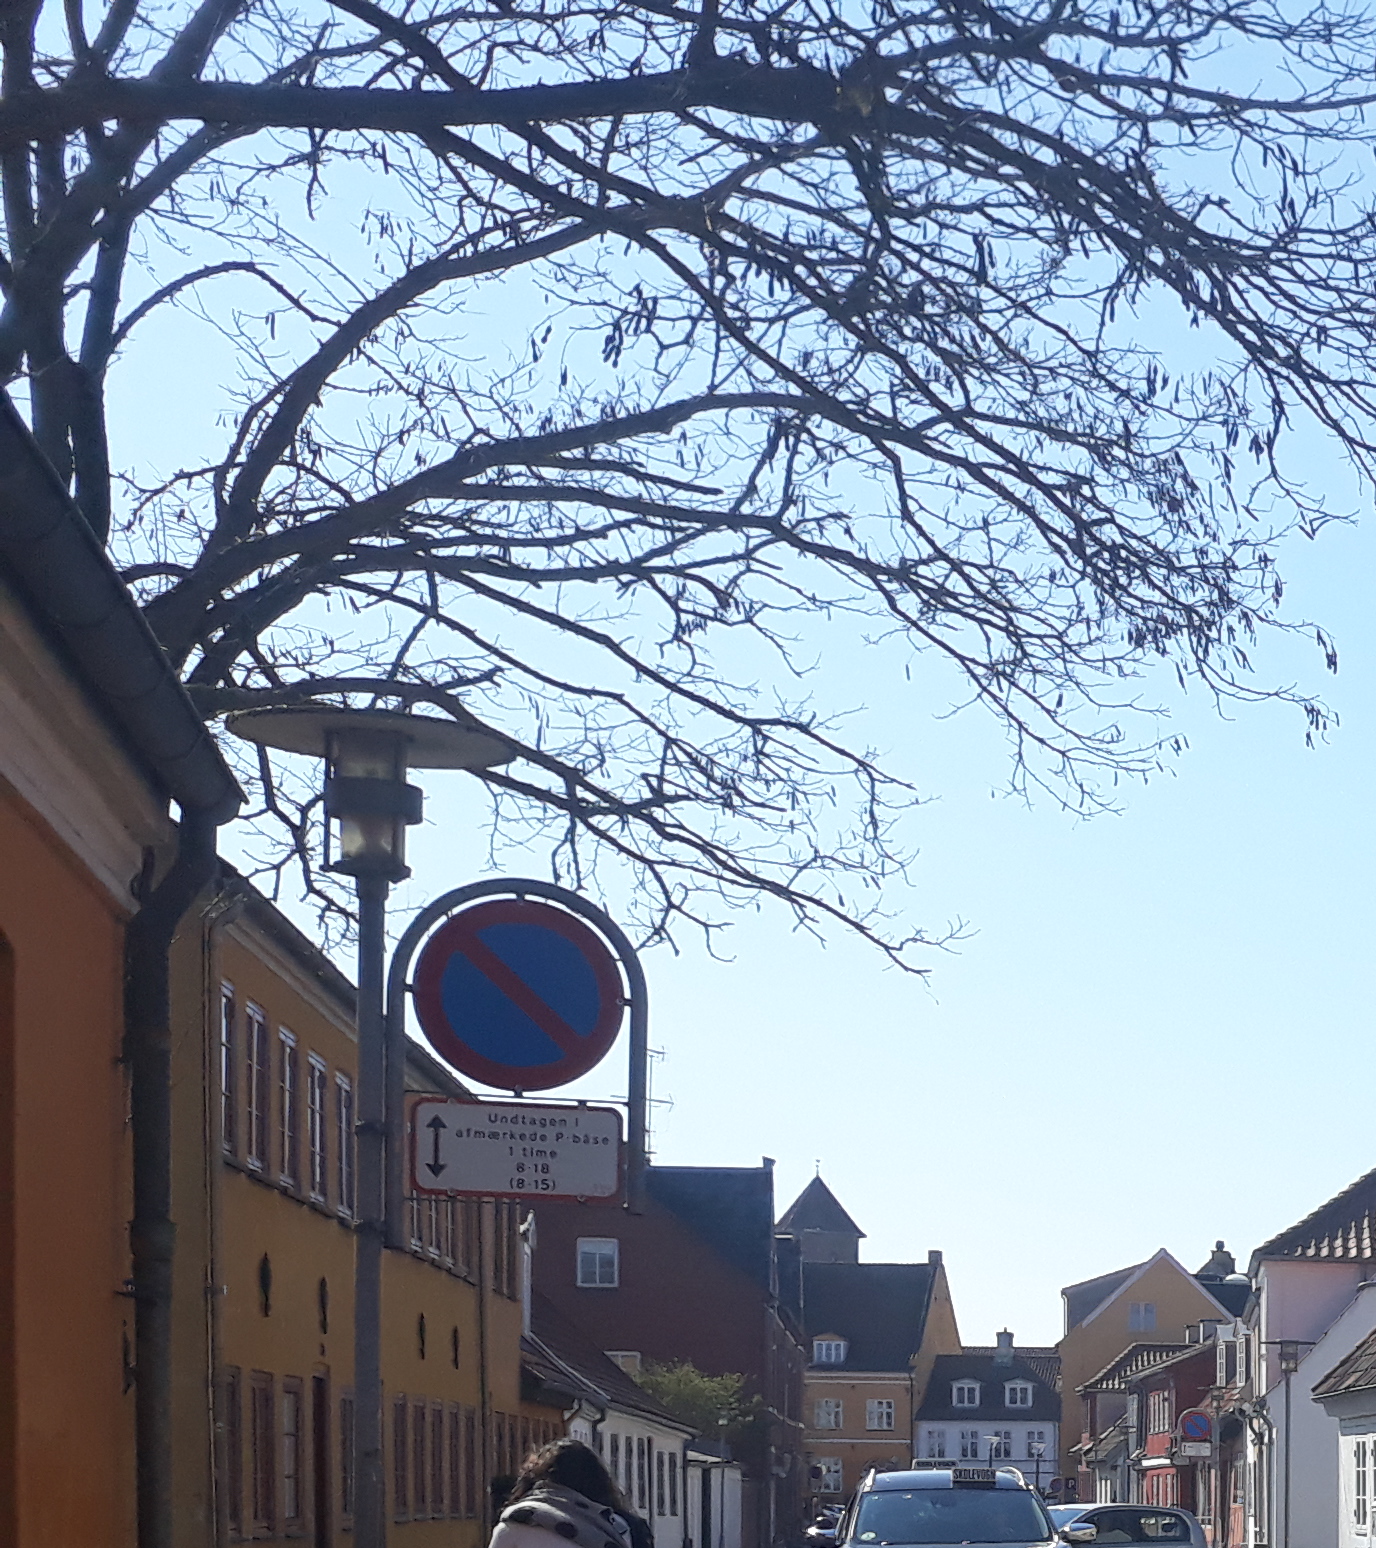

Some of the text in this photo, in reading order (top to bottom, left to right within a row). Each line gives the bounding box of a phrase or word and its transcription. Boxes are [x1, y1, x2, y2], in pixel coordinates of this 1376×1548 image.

[488, 1113, 568, 1128] Undtagen
[455, 1128, 548, 1142] afmærkede
[508, 1146, 558, 1159] 1 time
